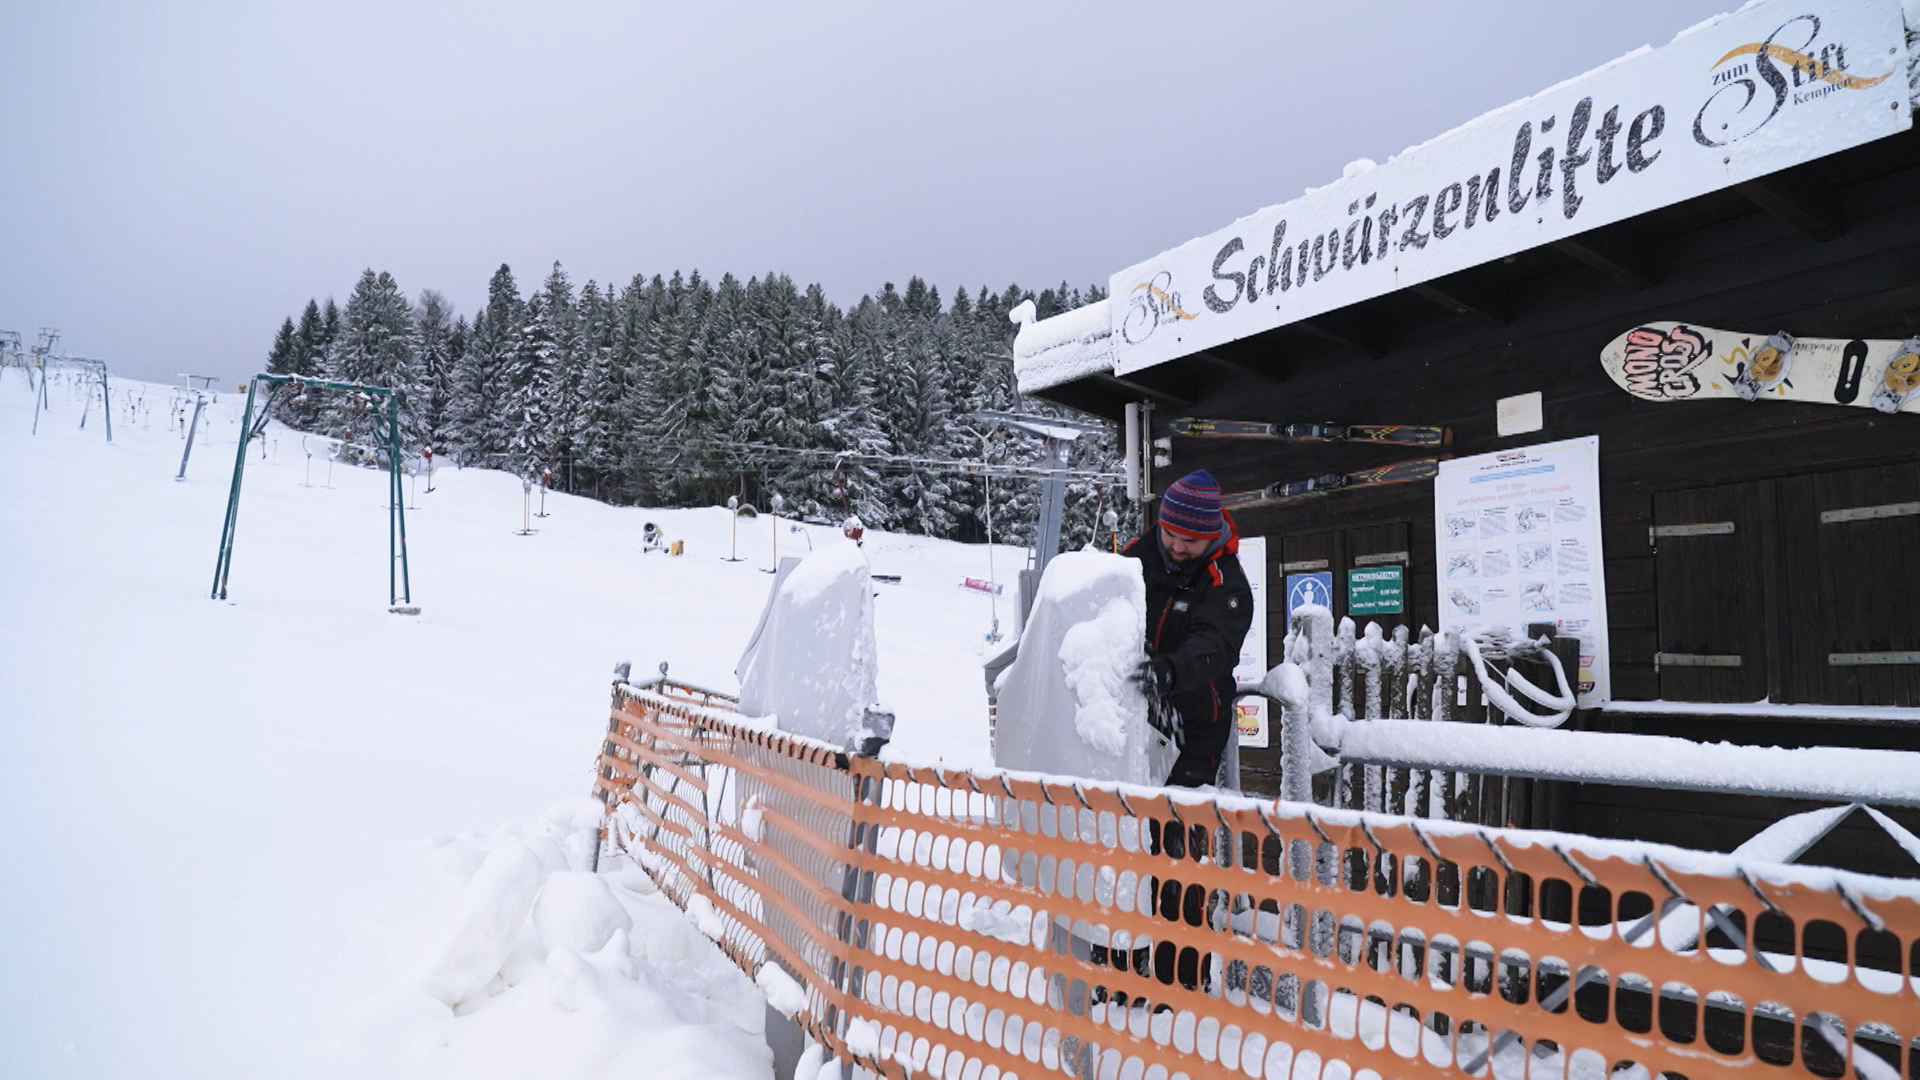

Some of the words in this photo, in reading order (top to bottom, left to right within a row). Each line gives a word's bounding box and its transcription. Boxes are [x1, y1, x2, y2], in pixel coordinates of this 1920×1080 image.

[1692, 13, 1851, 149] Stift
[1711, 63, 1750, 86] zum
[1793, 76, 1854, 106] Kempten
[1622, 326, 1668, 398] MONO
[1659, 324, 1713, 399] CROSS
